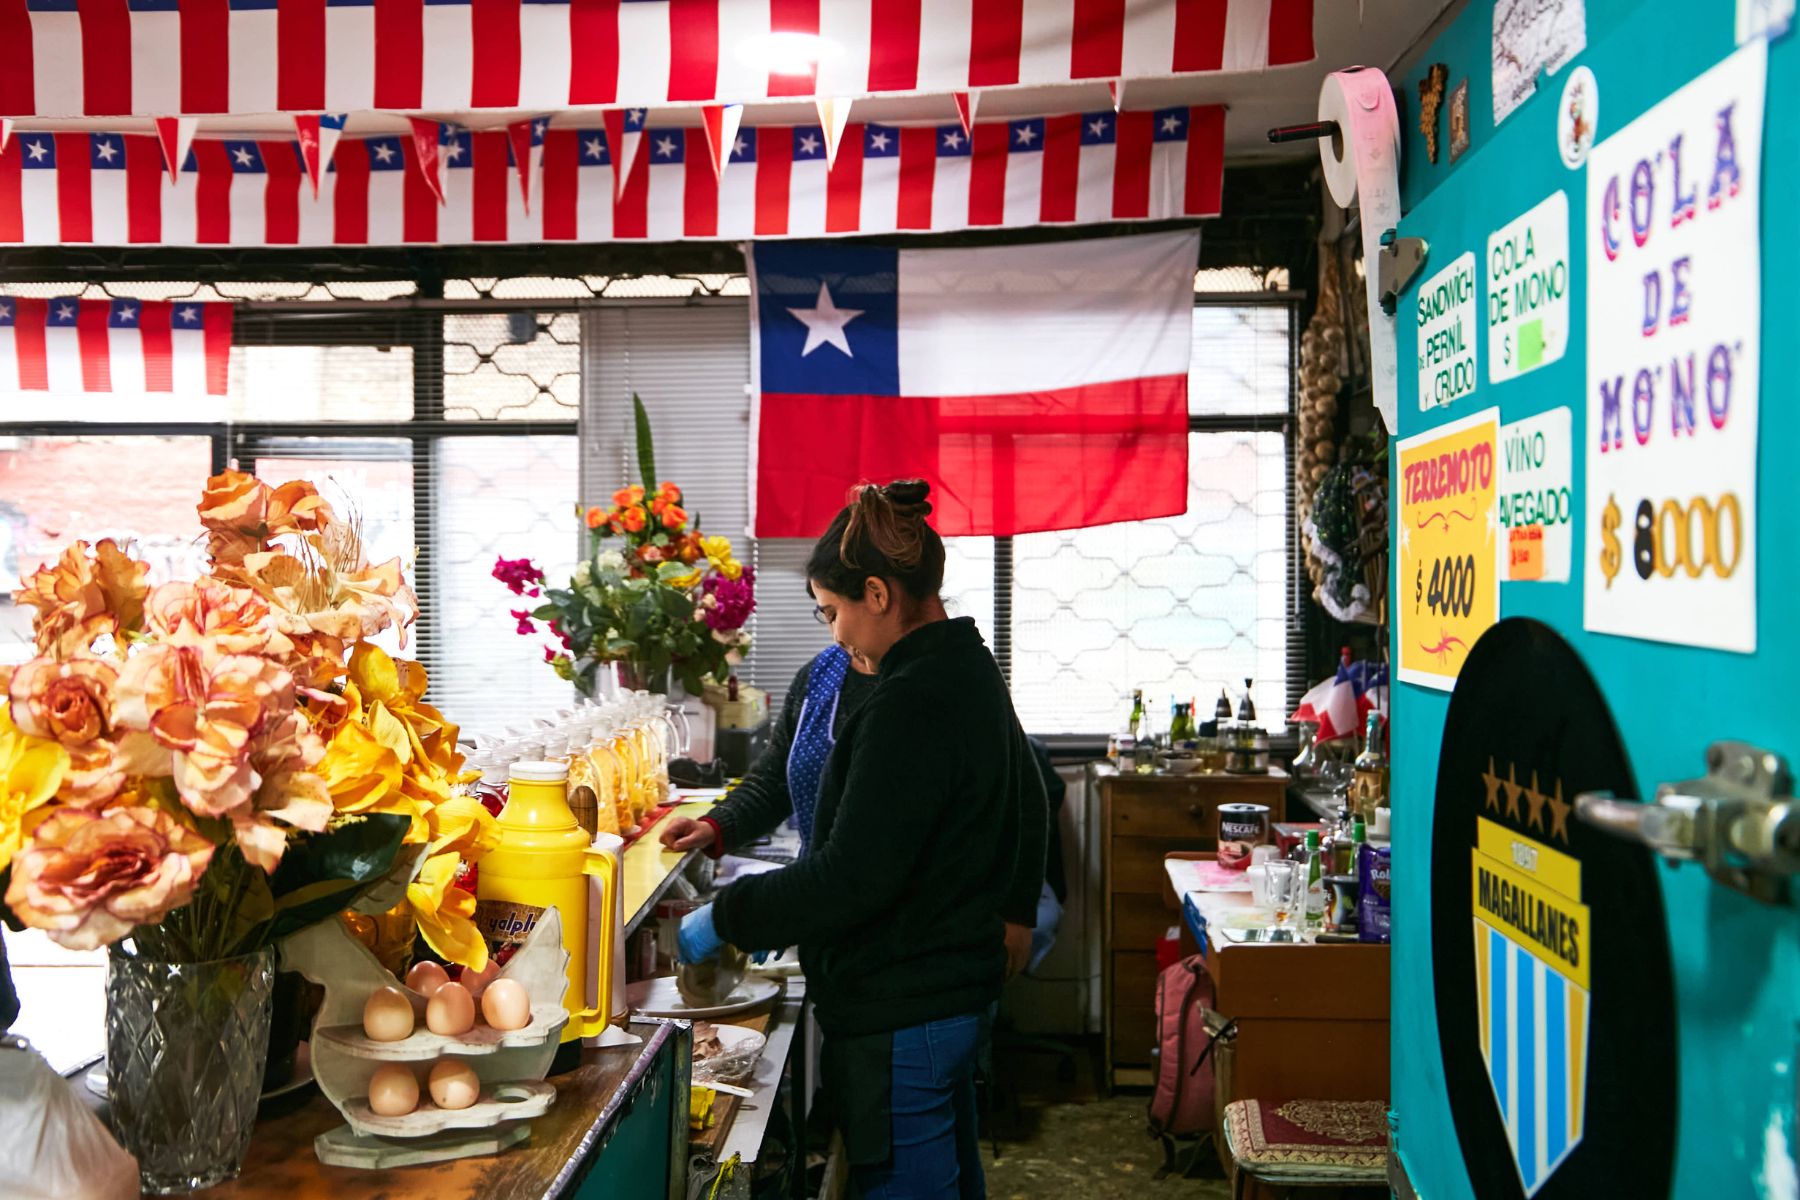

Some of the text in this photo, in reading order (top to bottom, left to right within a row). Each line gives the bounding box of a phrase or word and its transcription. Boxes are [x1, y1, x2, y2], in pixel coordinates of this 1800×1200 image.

[1493, 226, 1535, 281] COLA
[1489, 260, 1565, 326] DE MONO
[1642, 257, 1690, 337] DE
[1435, 357, 1475, 404] CRUDO
[1405, 441, 1493, 506] TERREMOTO
[1500, 486, 1571, 528] AVEGADO
[1478, 866, 1579, 968] MAGALLANES
